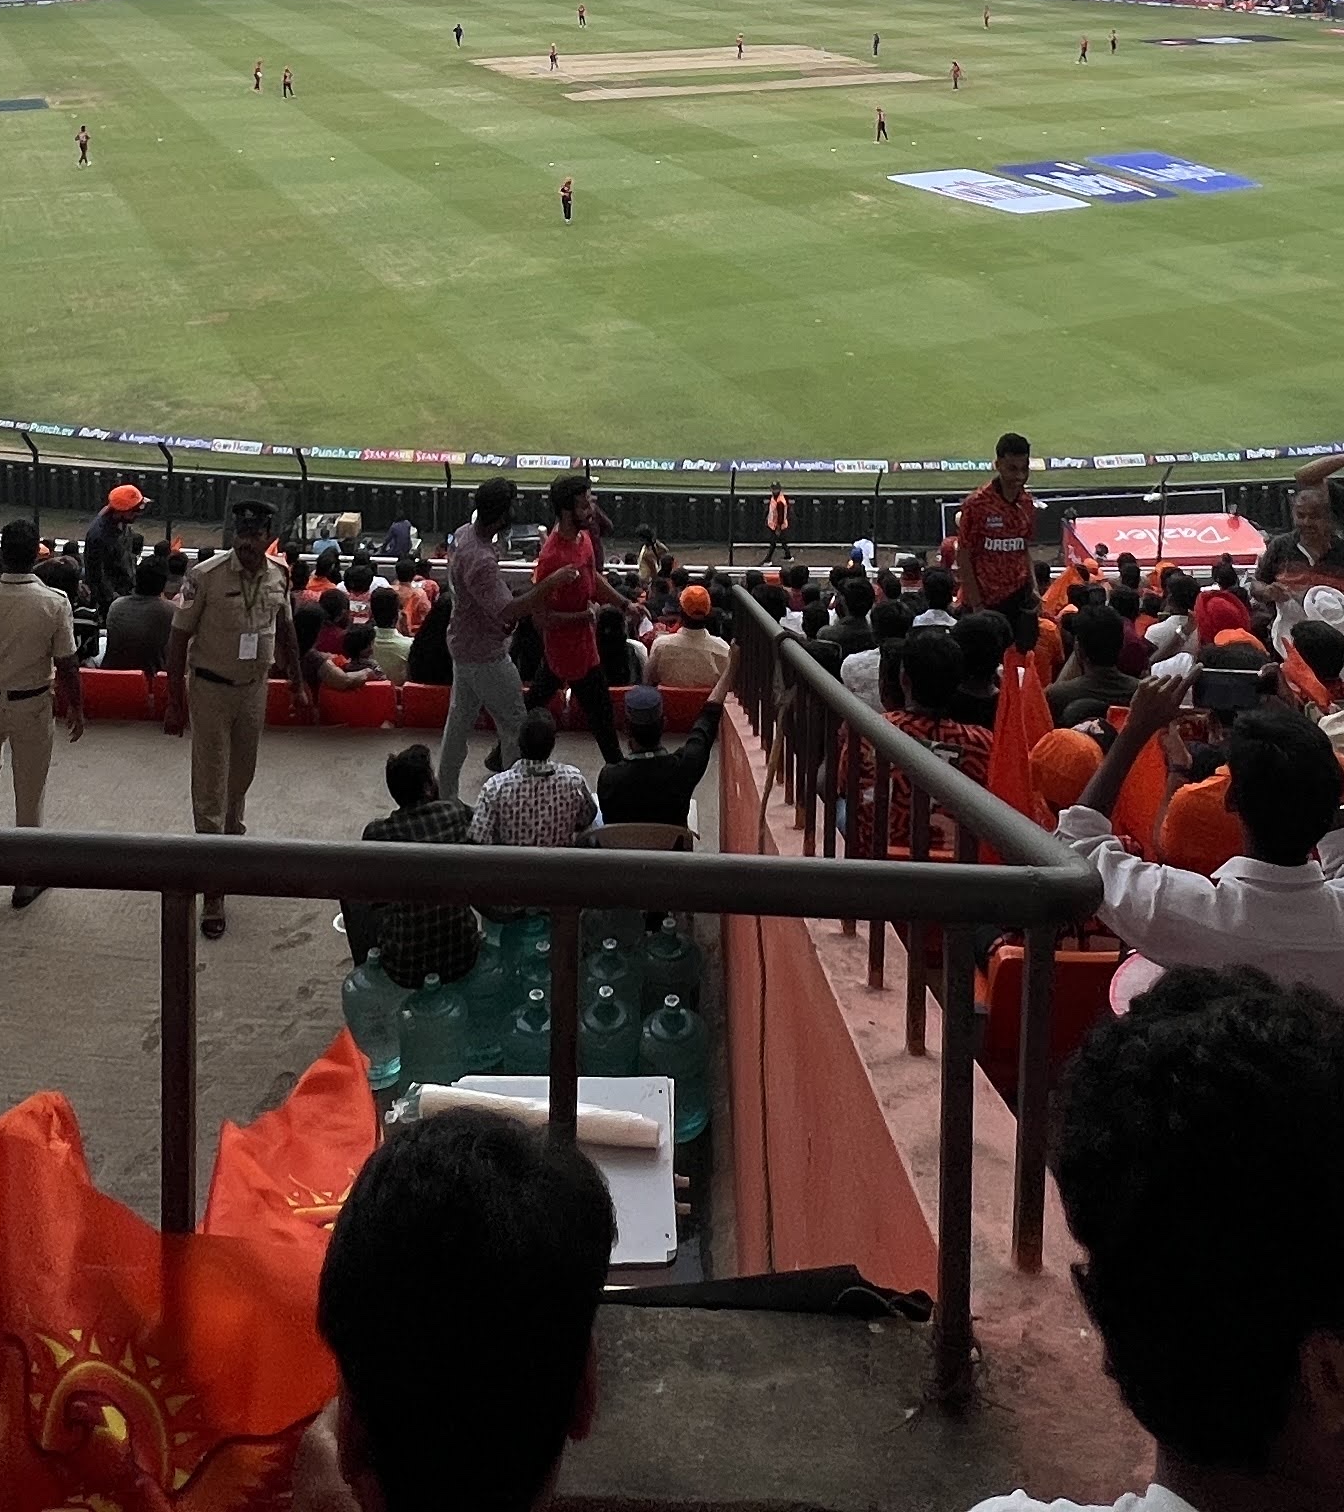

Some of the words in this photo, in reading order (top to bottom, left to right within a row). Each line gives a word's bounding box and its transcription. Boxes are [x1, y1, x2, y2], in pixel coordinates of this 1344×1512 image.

[29, 422, 75, 437] Punch.ev
[78, 427, 111, 440] RuPay
[311, 446, 361, 459] Punch.ev
[1192, 451, 1241, 462] Punch.ev
[1246, 448, 1276, 460] RuPay
[471, 452, 506, 466] RuPay
[622, 458, 675, 471] Punch.ev
[1050, 457, 1084, 469] RuPay
[682, 459, 718, 472] RuPay
[740, 460, 782, 472] AngelOne
[793, 460, 834, 472] AngelOne
[900, 462, 922, 471] TATA
[940, 460, 993, 472] Punch.ev
